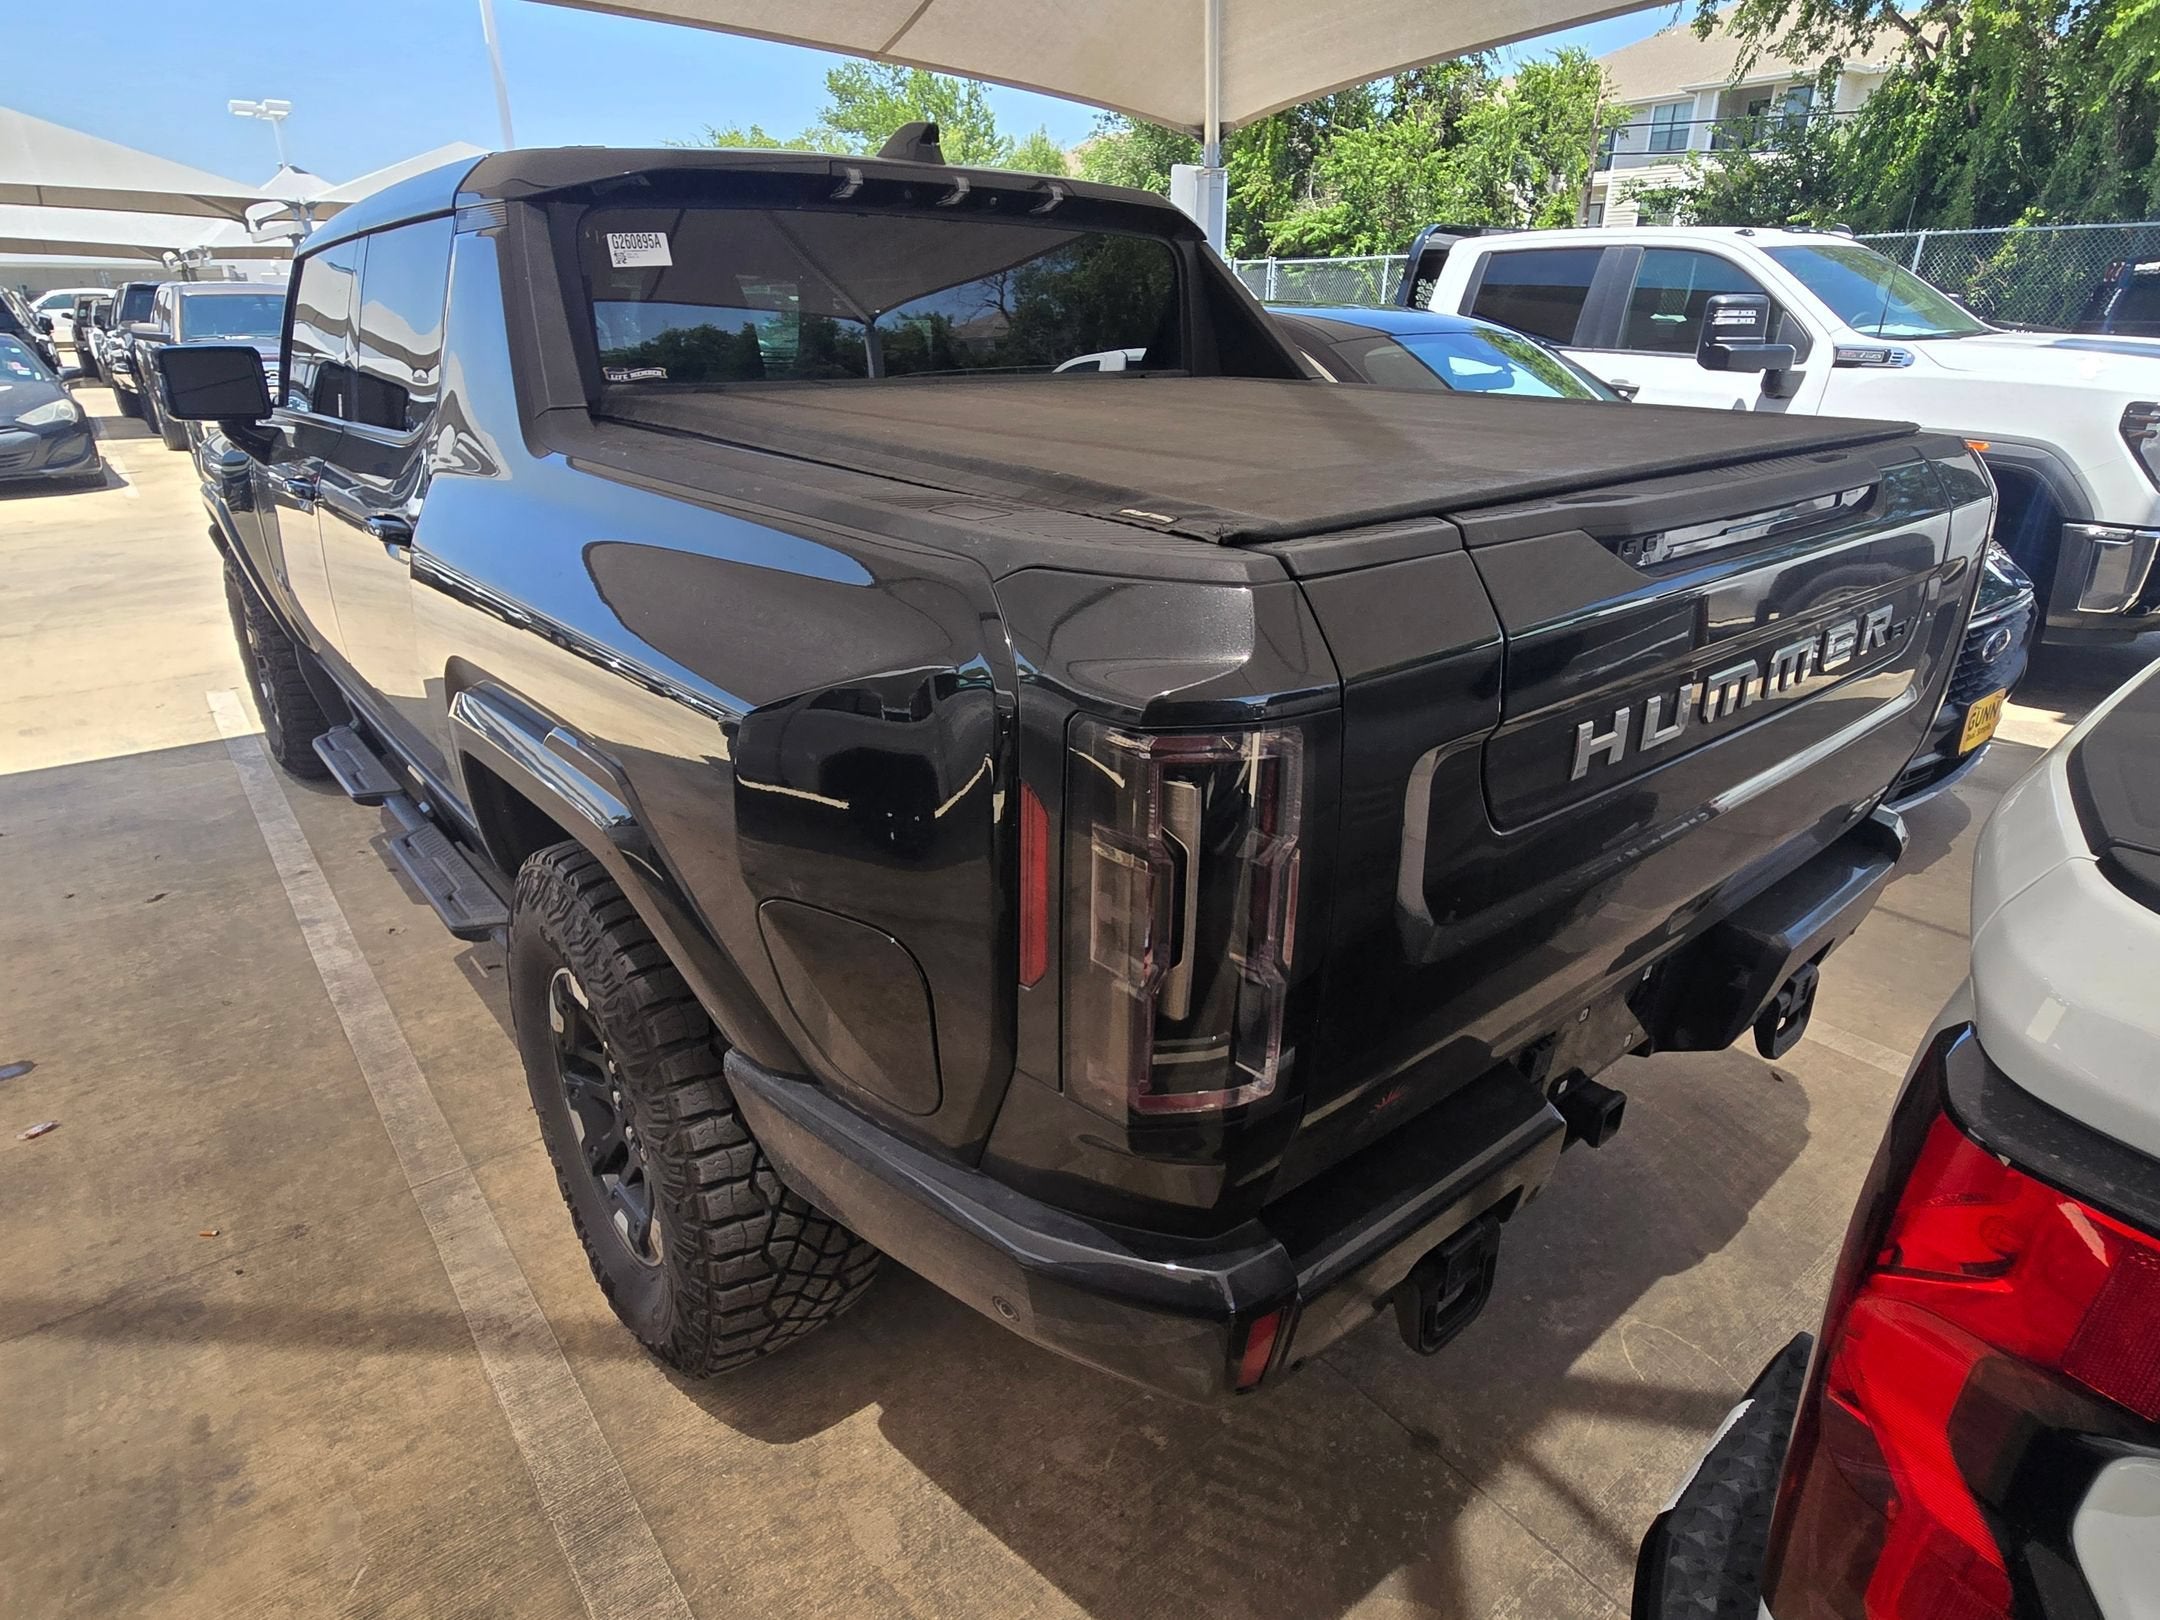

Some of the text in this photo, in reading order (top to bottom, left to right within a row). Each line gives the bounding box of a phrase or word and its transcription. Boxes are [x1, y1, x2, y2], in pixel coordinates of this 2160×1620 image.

[611, 233, 662, 249] G260895A
[1571, 604, 1893, 781] HUMMER
[1968, 700, 2001, 731] GUNN
